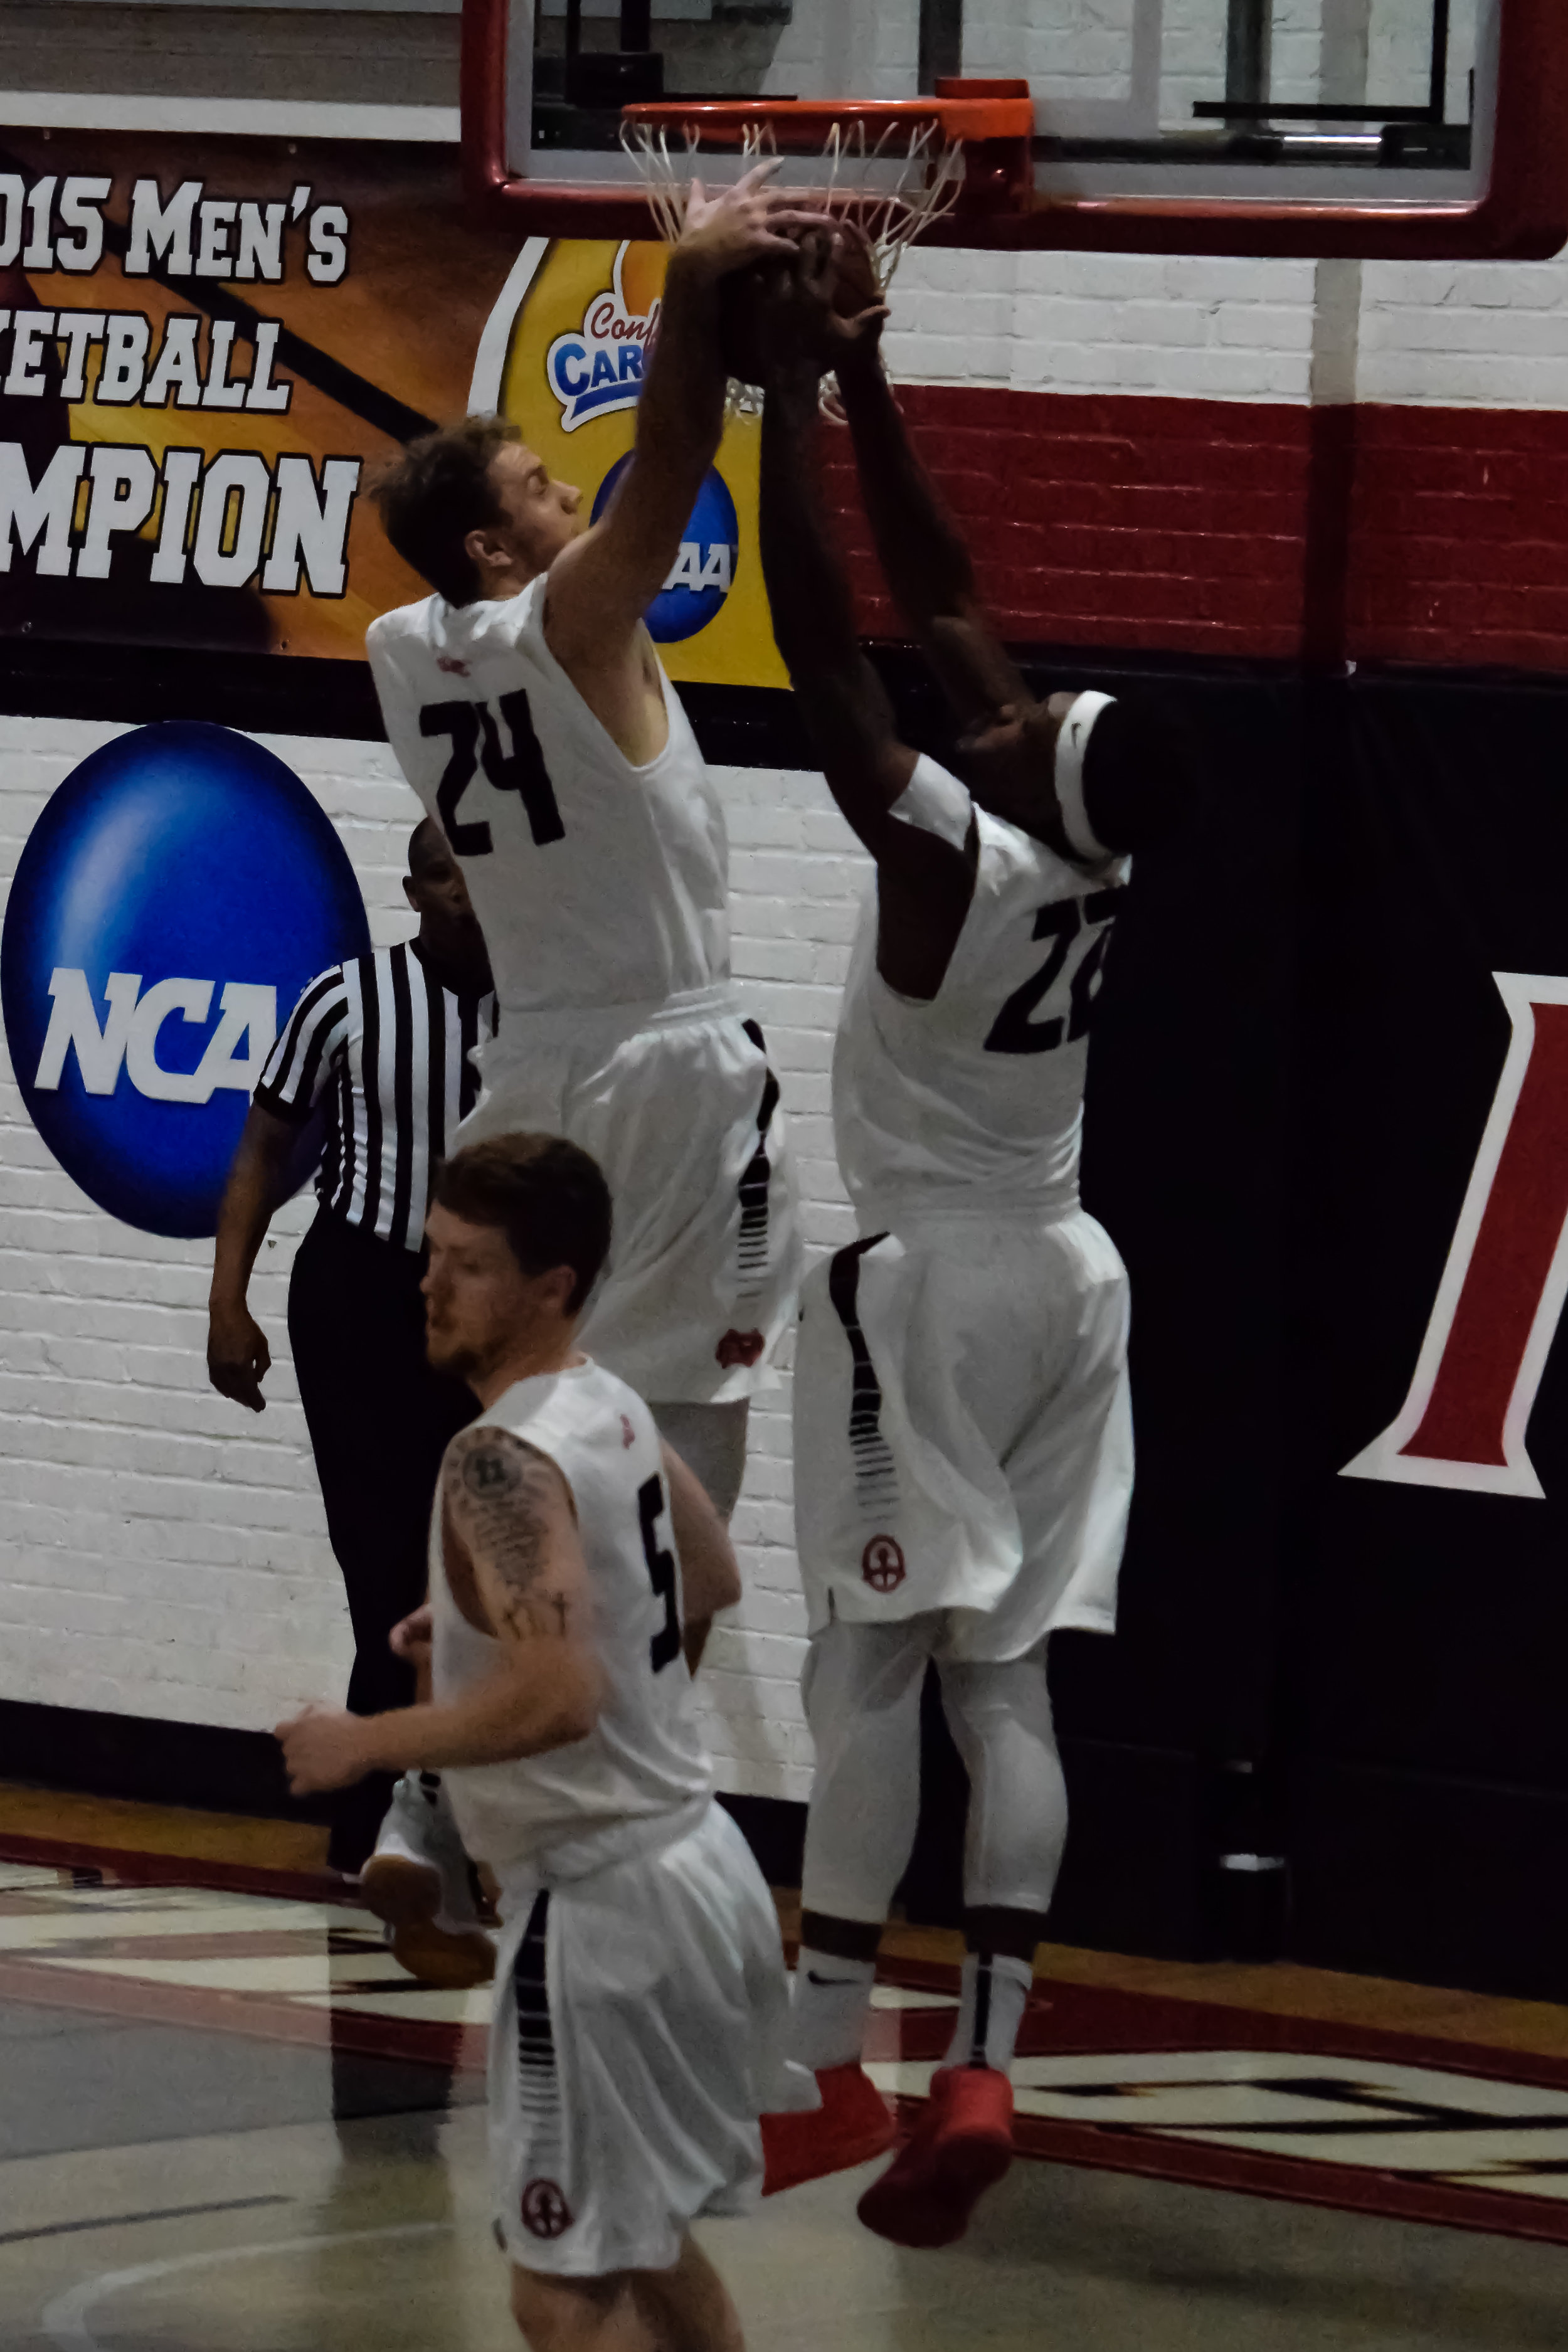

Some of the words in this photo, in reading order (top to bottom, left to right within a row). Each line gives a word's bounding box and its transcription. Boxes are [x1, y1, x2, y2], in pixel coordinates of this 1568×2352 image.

[125, 179, 348, 282] MEN'S
[554, 343, 648, 396] CAR
[0, 442, 361, 593] MPION
[662, 541, 731, 593] AA
[419, 688, 565, 856] 24
[34, 967, 277, 1106] NCA
